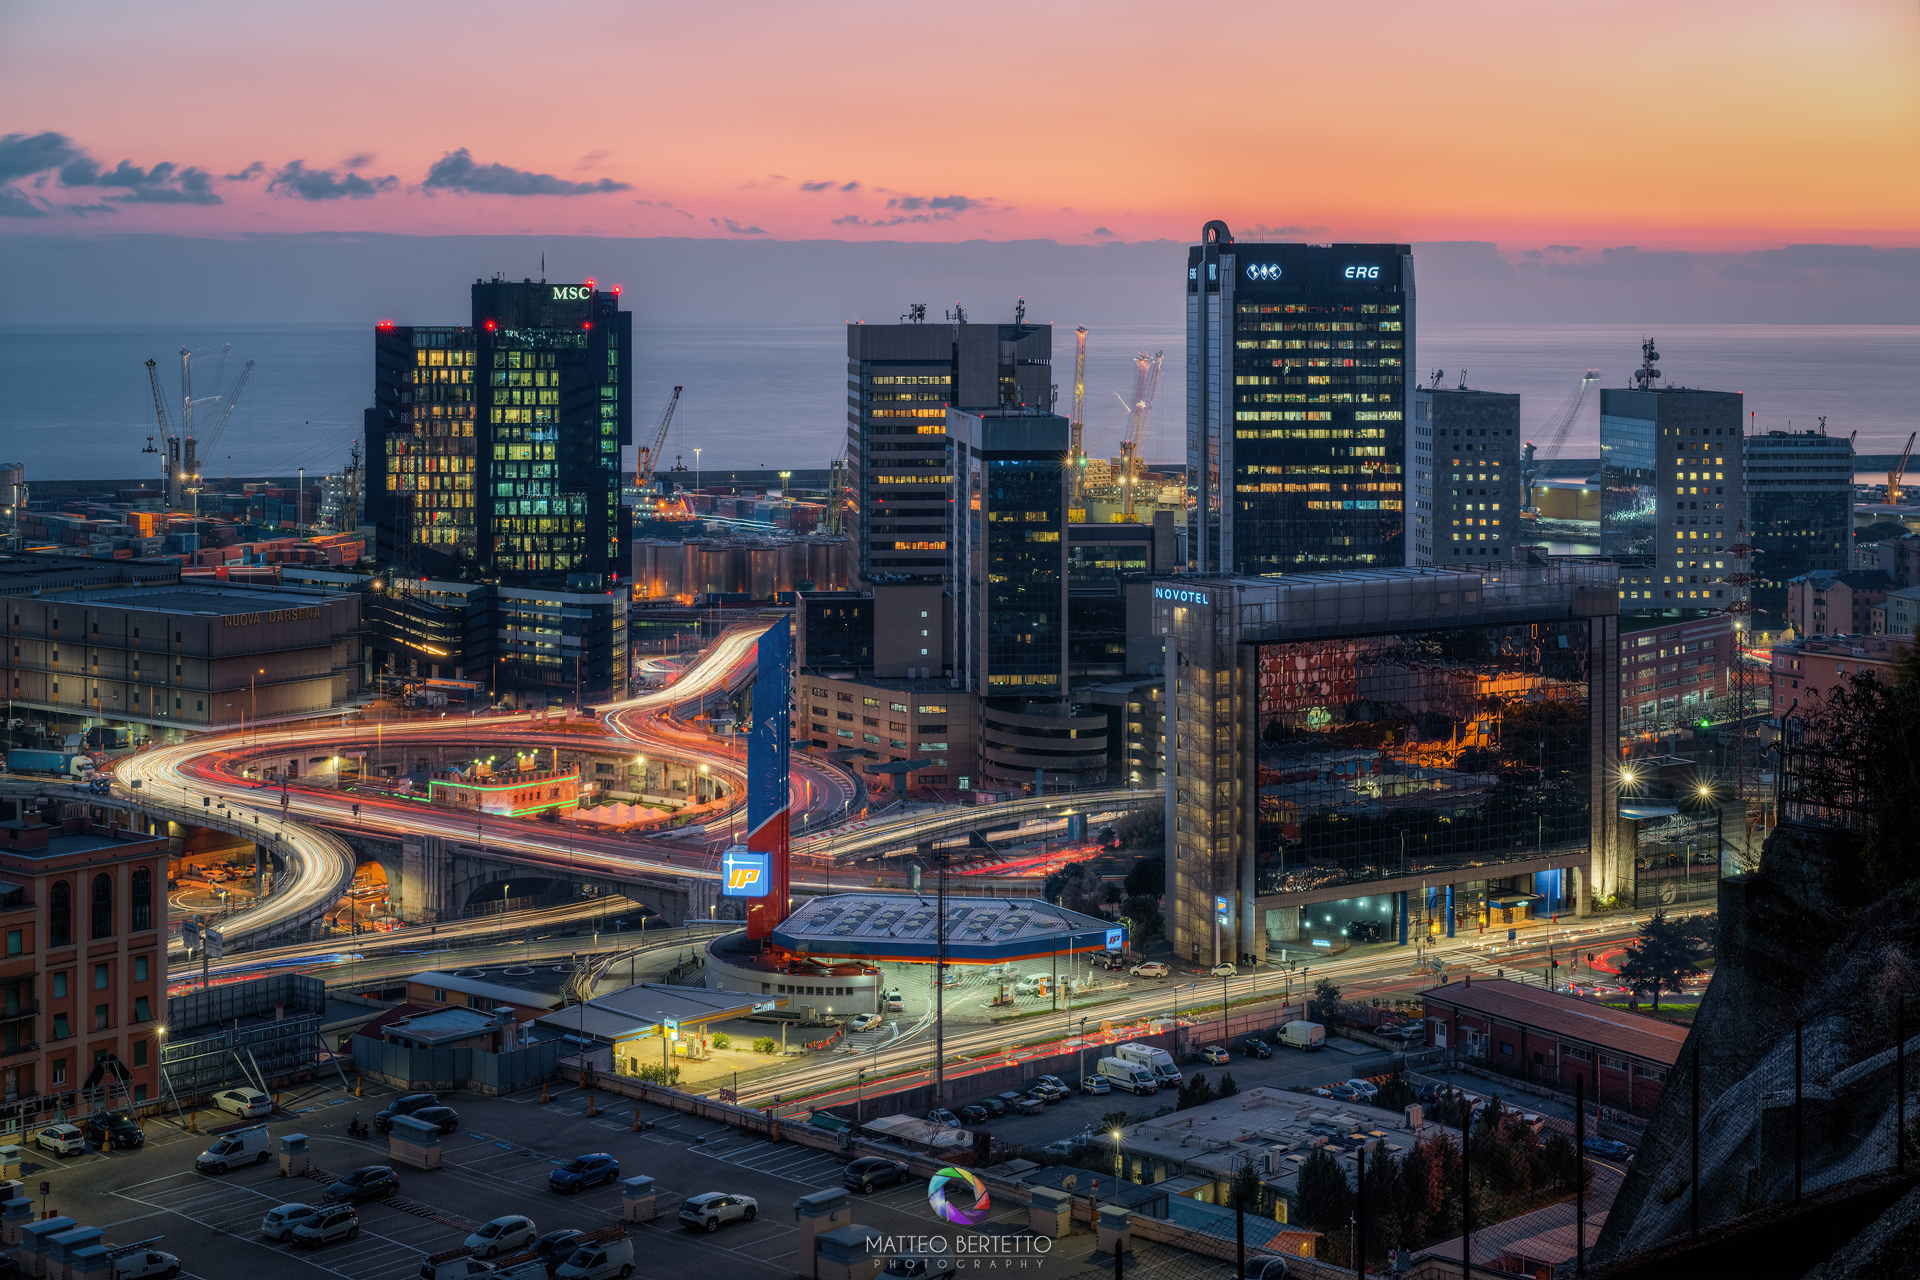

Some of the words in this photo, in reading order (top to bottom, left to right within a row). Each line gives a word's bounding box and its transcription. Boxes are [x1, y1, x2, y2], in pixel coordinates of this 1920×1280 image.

[1344, 266, 1380, 279] ERG
[552, 286, 591, 300] MSC
[1155, 587, 1209, 605] NOVOTEL
[224, 612, 260, 627] NUOVA
[269, 606, 321, 623] DARSENA
[727, 868, 760, 889] IP
[1108, 934, 1121, 945] IP
[762, 1000, 776, 1012] eni
